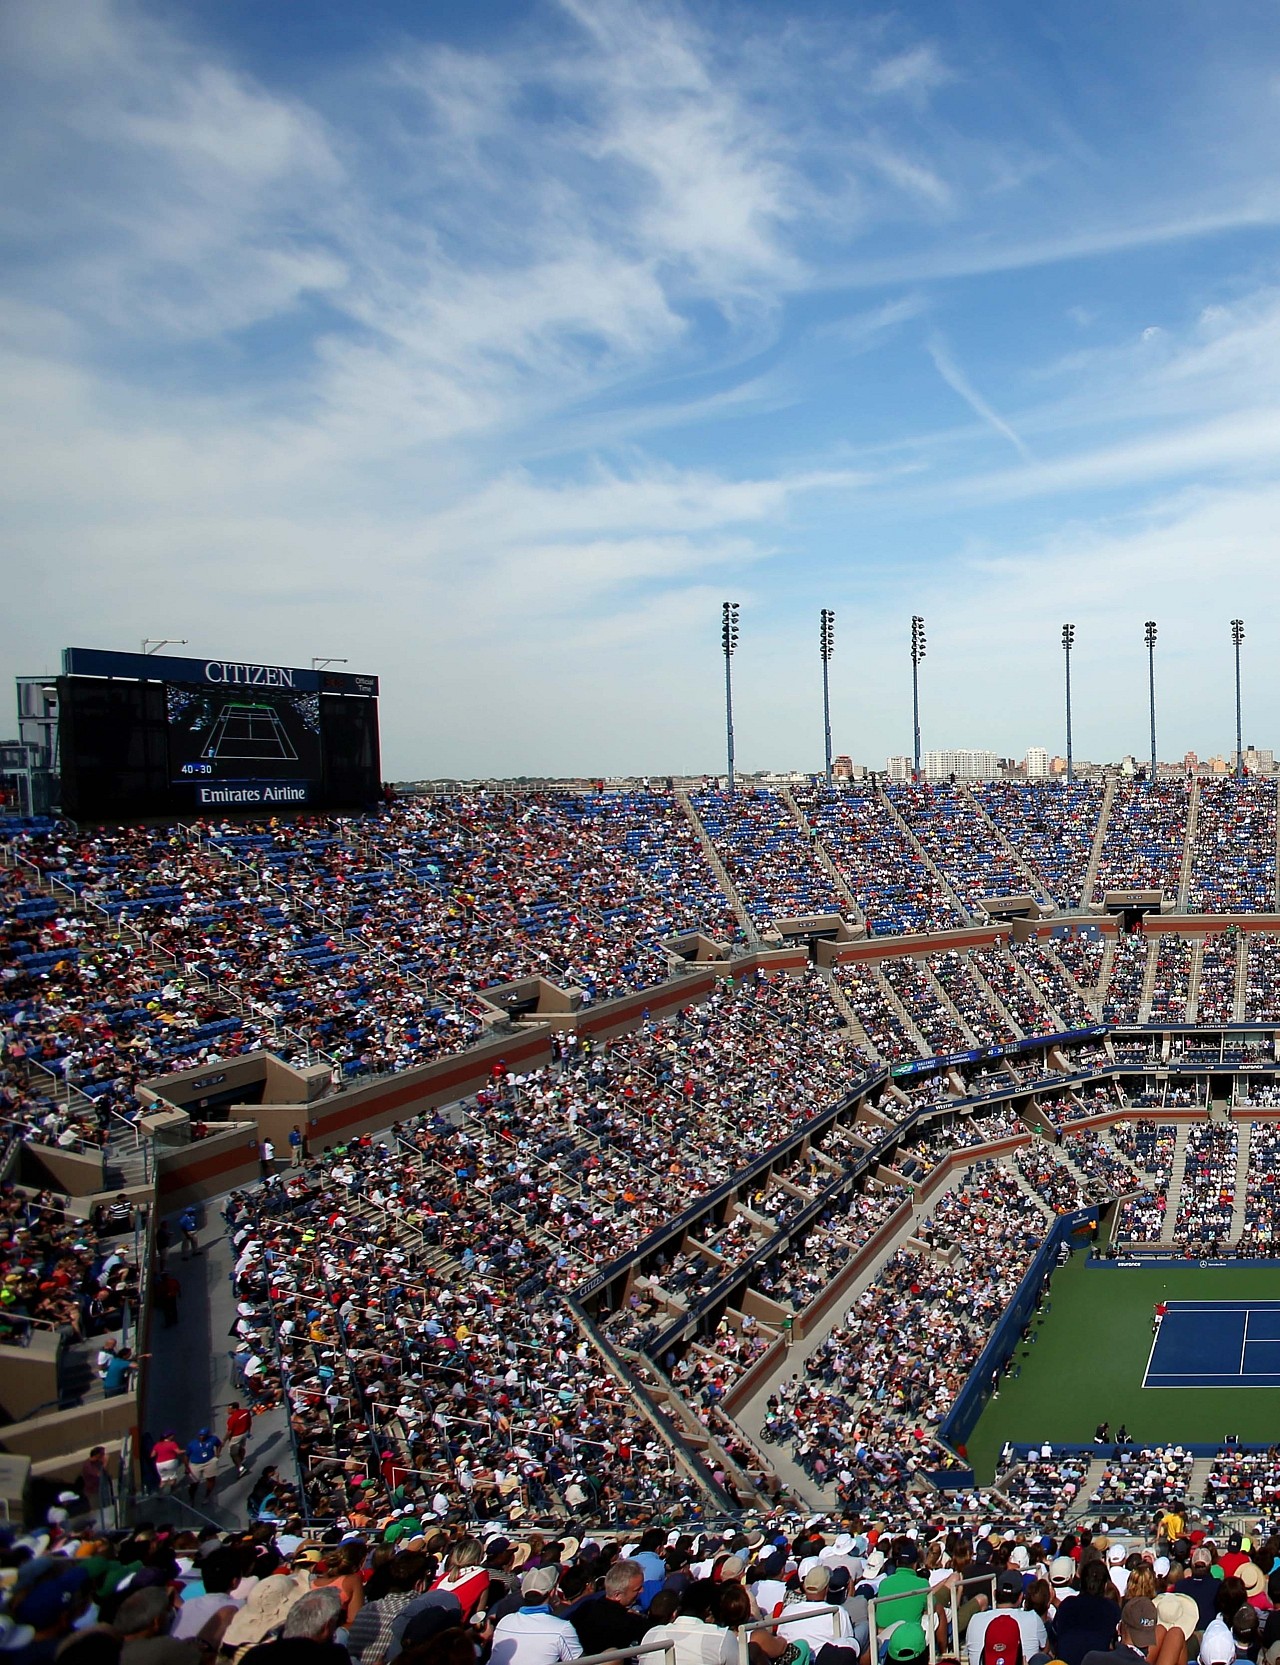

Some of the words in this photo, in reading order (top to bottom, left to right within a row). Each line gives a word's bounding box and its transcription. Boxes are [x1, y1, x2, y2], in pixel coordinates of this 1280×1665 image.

[205, 661, 295, 688] CITIZEN
[355, 677, 374, 686] Official
[357, 684, 372, 693] Time
[181, 765, 193, 774] 40
[201, 764, 212, 774] 30
[201, 788, 260, 802] Emirates
[263, 786, 305, 801] Airline
[935, 1103, 954, 1111] WESTIN
[579, 1271, 606, 1297] CITIZEN
